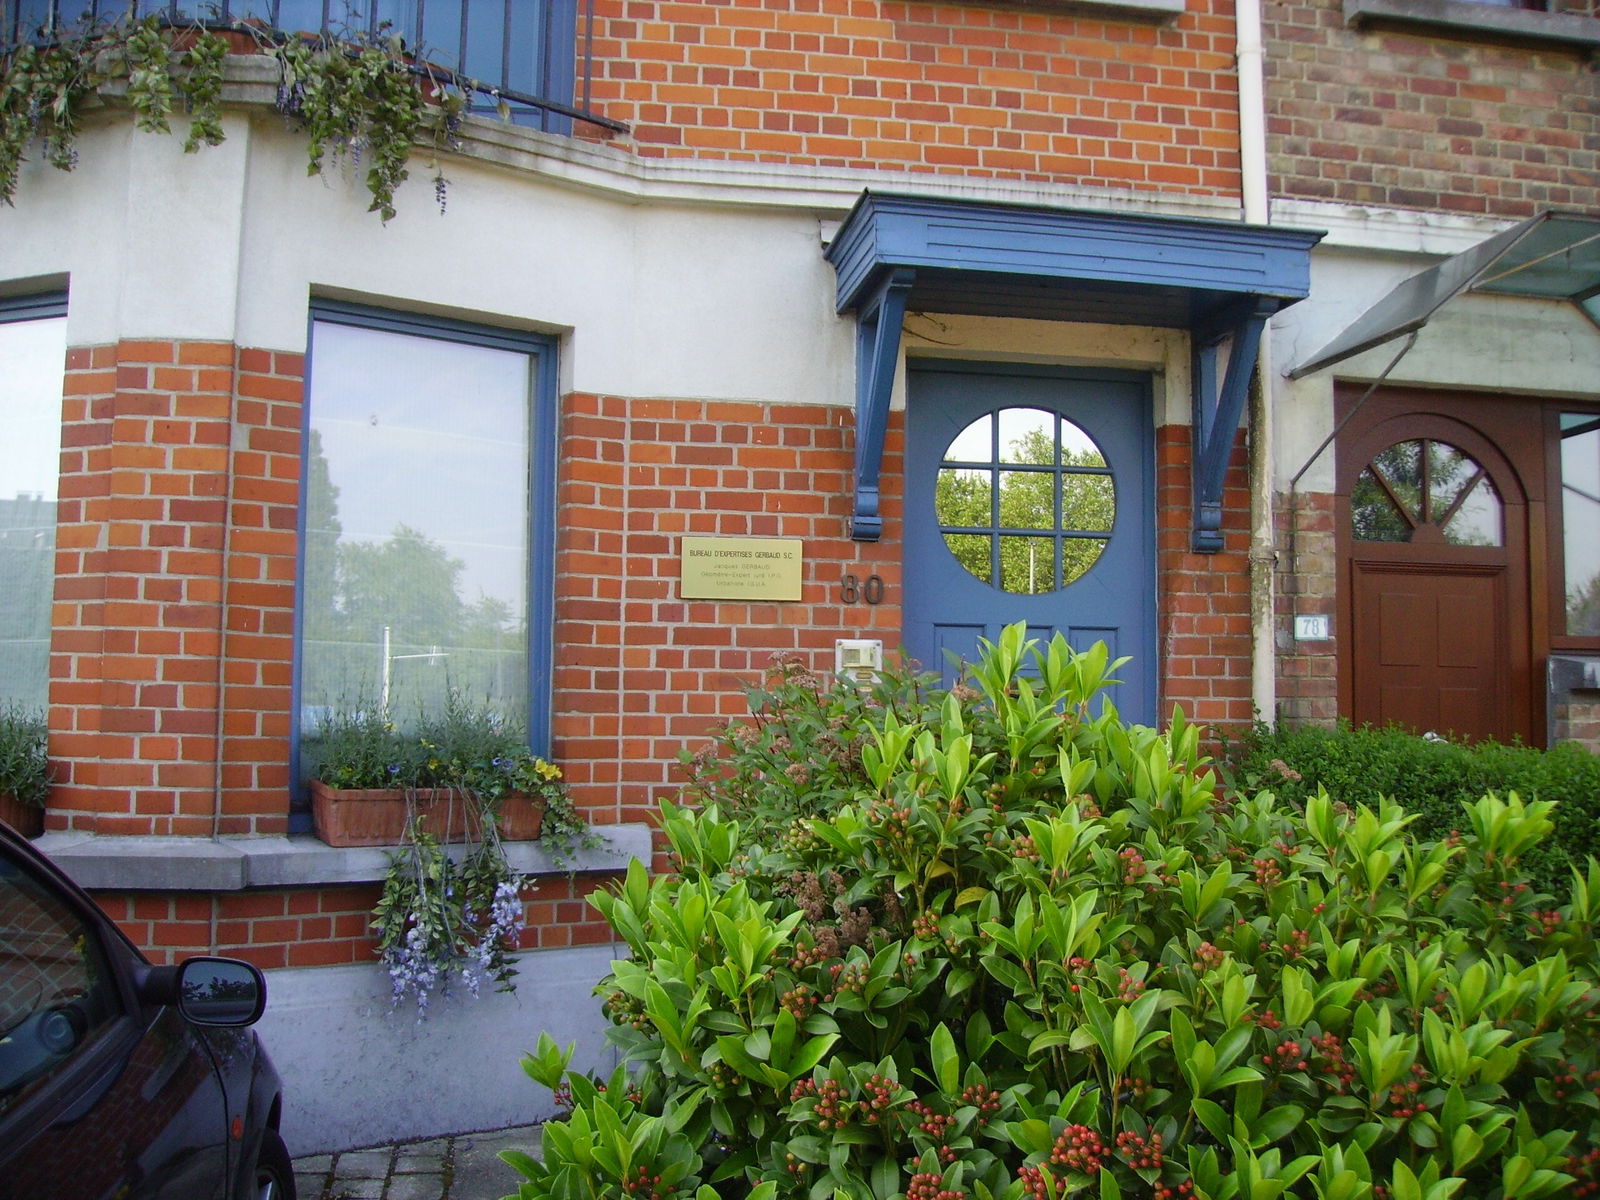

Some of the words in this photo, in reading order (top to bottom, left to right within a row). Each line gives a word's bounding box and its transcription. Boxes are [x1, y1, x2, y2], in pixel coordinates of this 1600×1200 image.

[689, 549, 712, 557] BUREAU
[714, 550, 753, 558] D'EXPERTISES
[754, 551, 781, 559] GERBAUD
[841, 574, 884, 604] 80
[1303, 618, 1320, 636] 78
